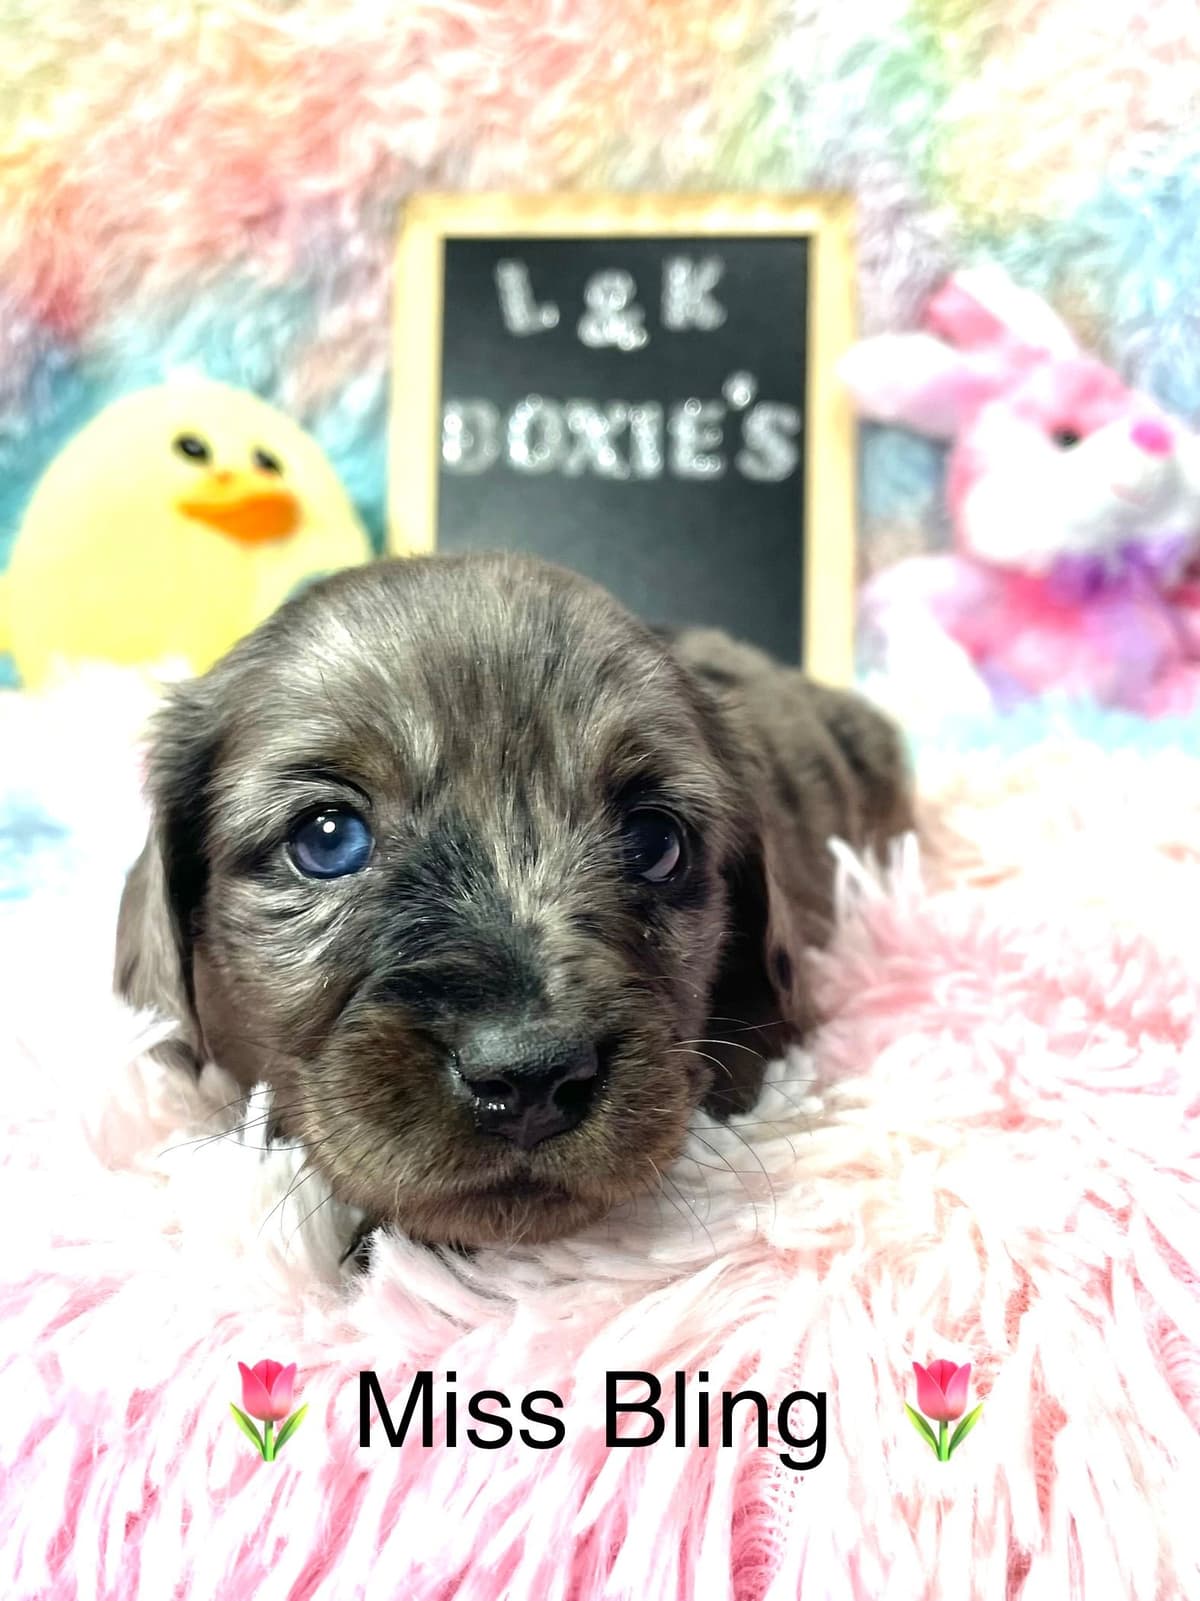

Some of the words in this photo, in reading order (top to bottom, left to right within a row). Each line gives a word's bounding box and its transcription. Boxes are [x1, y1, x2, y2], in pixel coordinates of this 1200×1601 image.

[496, 258, 560, 336] L
[577, 268, 648, 351] &
[661, 254, 727, 330] K
[442, 372, 800, 481] DOXIE'S
